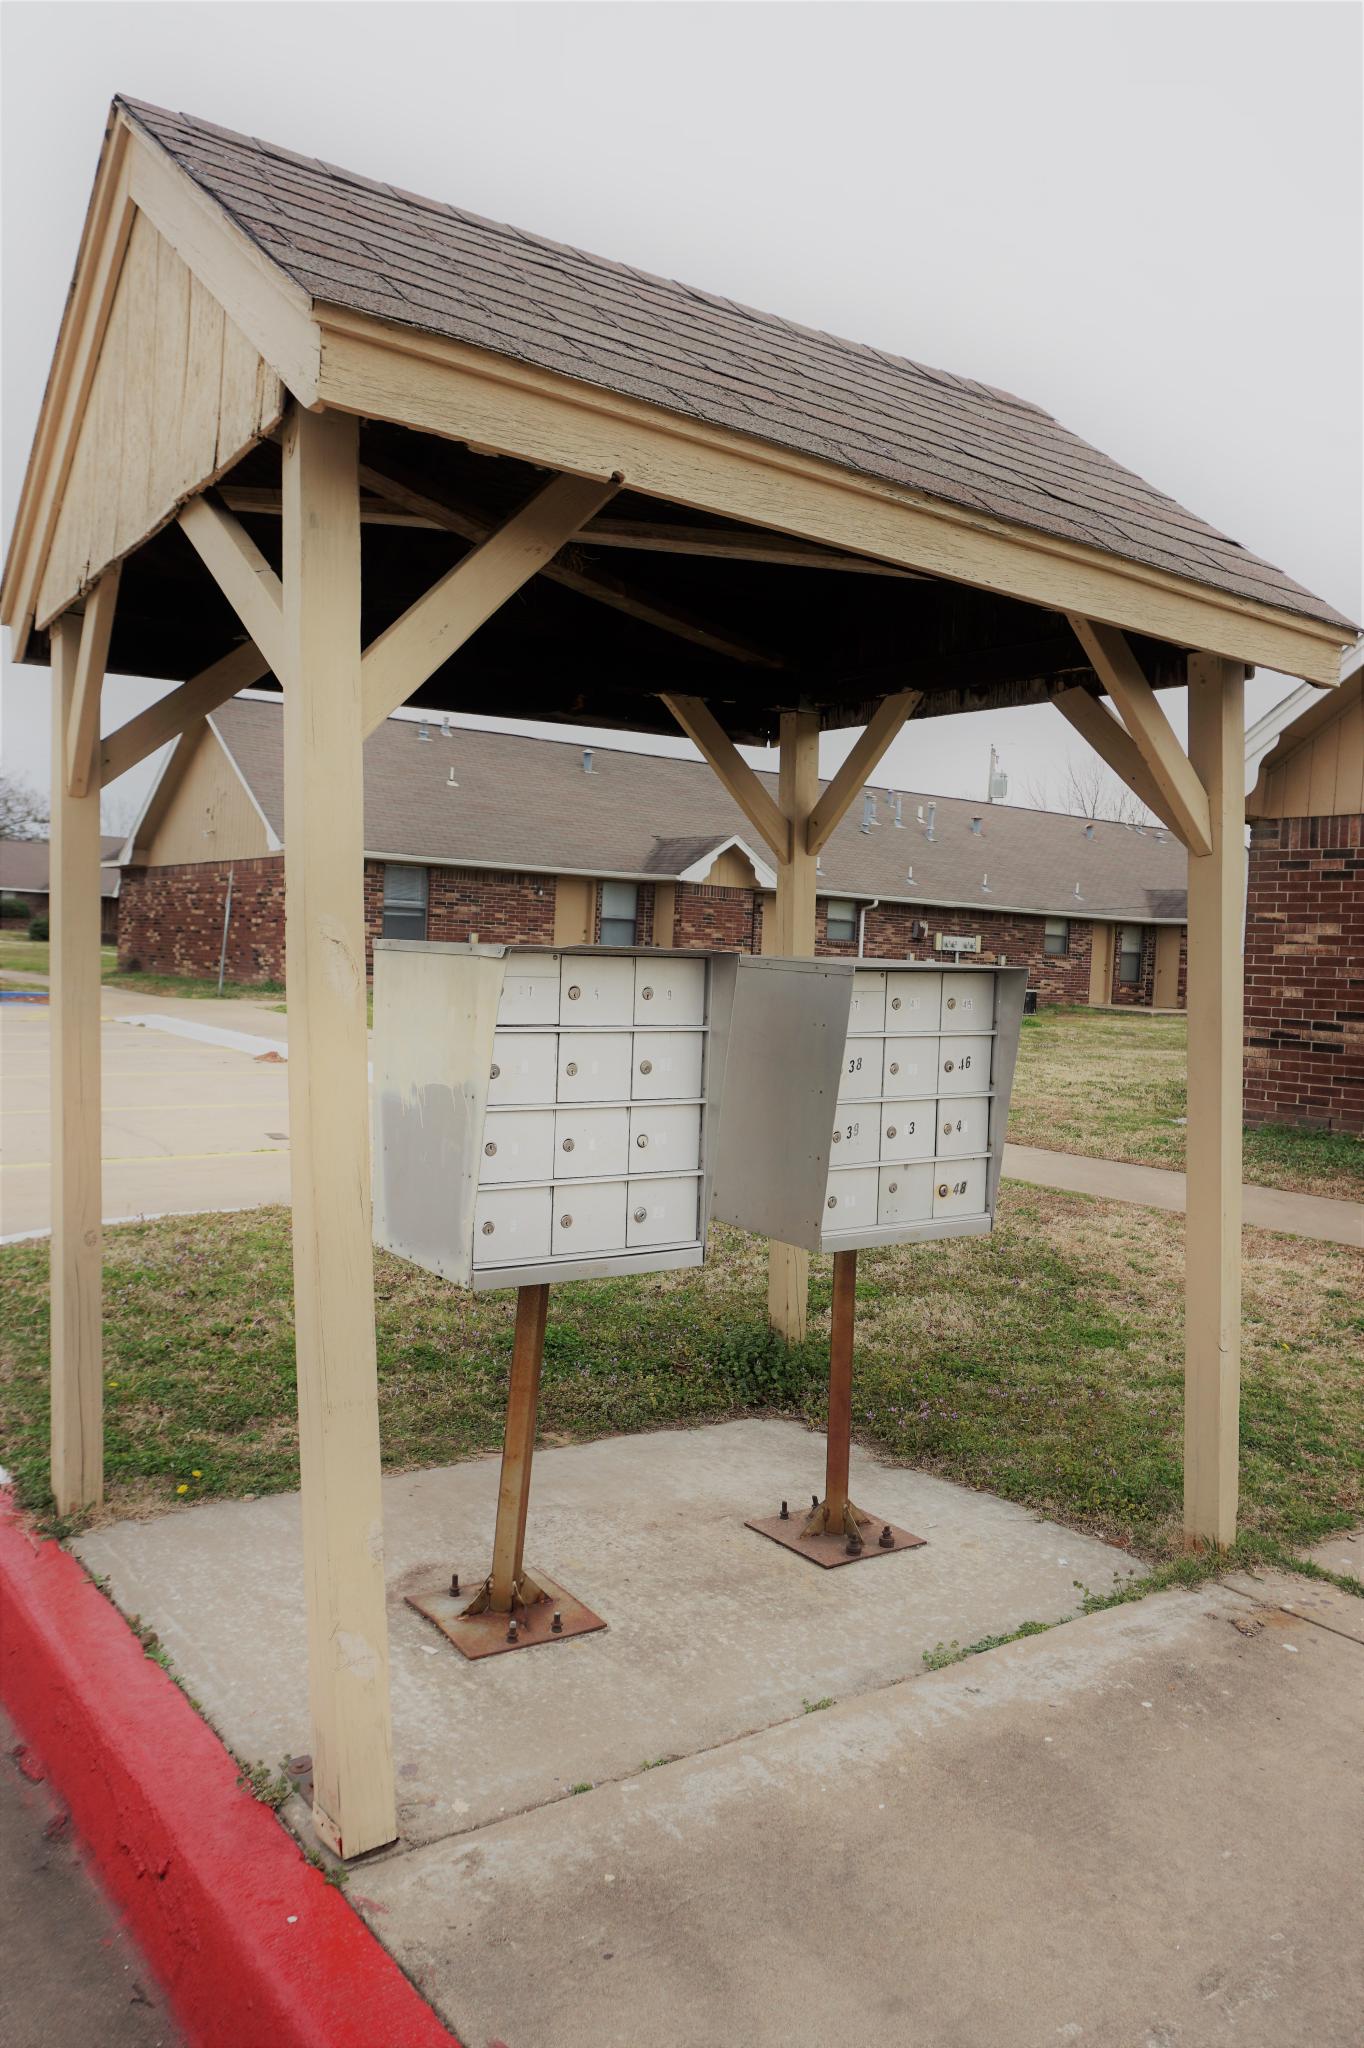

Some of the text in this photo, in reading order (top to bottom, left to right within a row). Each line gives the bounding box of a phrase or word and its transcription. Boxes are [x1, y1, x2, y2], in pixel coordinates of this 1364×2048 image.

[848, 1057, 863, 1073] 38
[846, 1122, 860, 1140] 39
[953, 1181, 968, 1196] 48
